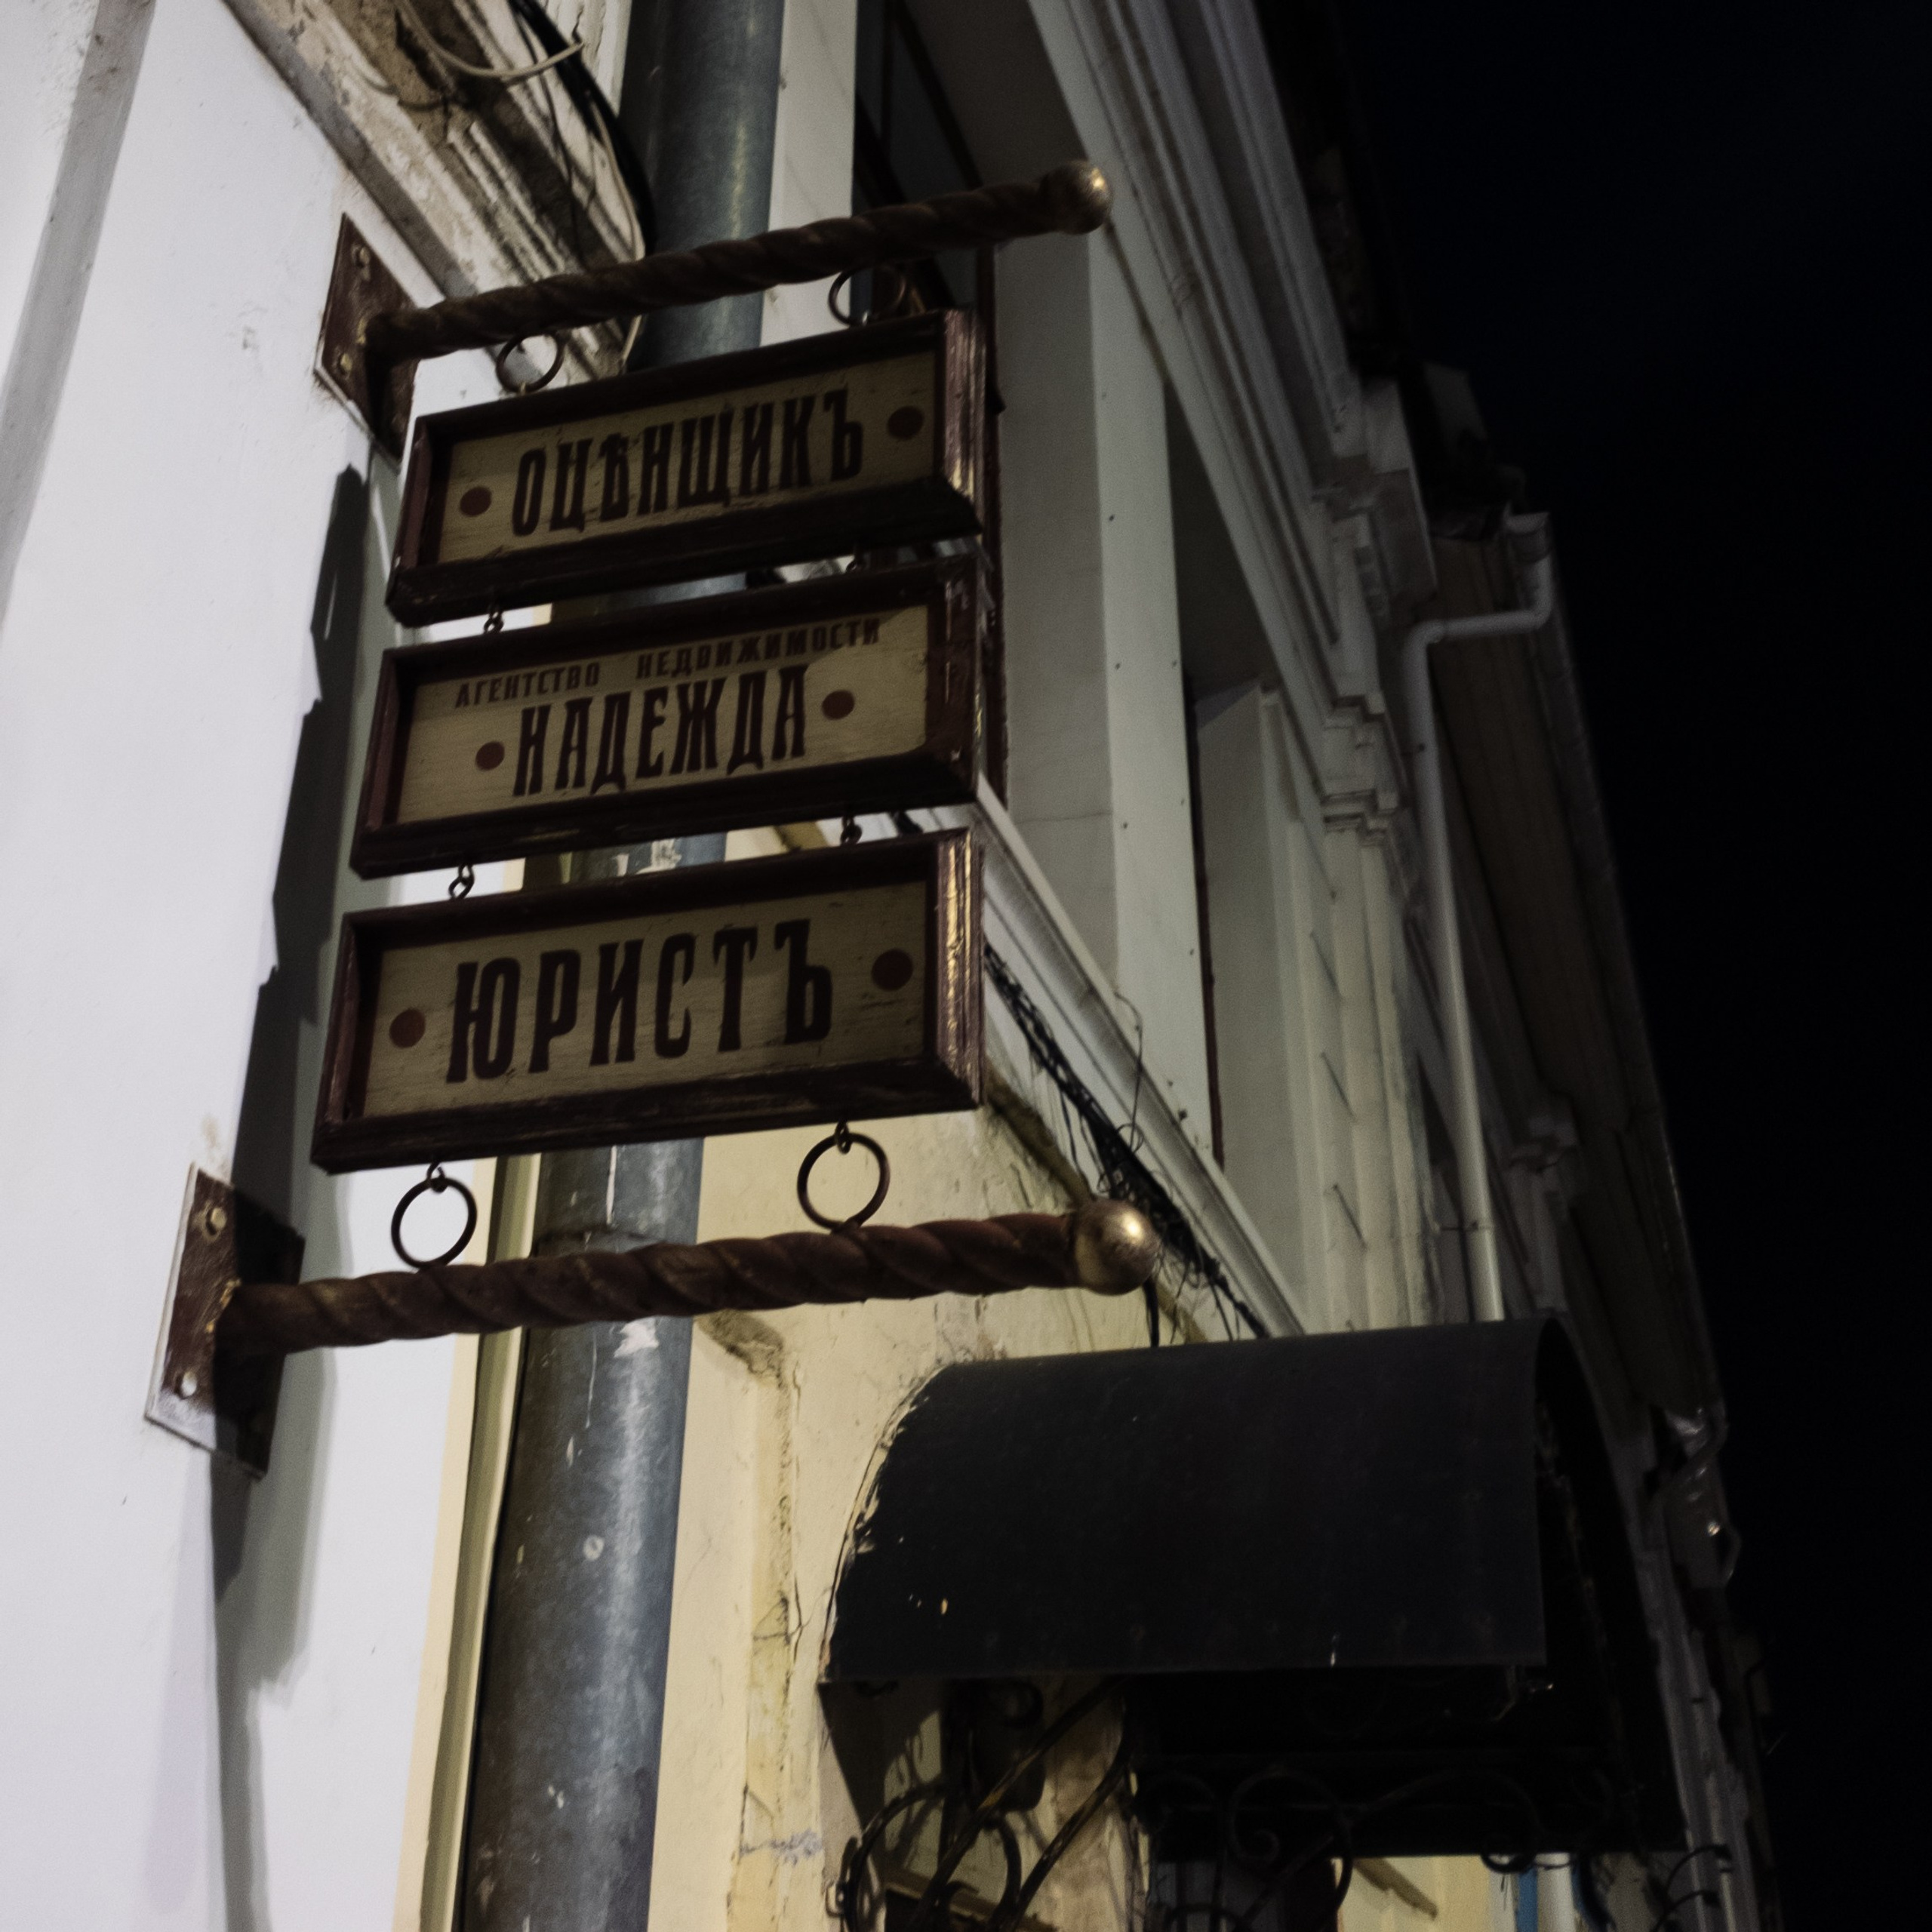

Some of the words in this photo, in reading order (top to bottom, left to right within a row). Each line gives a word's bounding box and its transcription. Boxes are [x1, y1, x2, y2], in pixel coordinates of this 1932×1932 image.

[455, 661, 601, 709] АГЕНТСТВО
[635, 617, 881, 679] НЕДВИЖИМОСТИ
[512, 663, 811, 797] НАДЕЖДА
[445, 918, 833, 1083] ЮРИСТЪ
